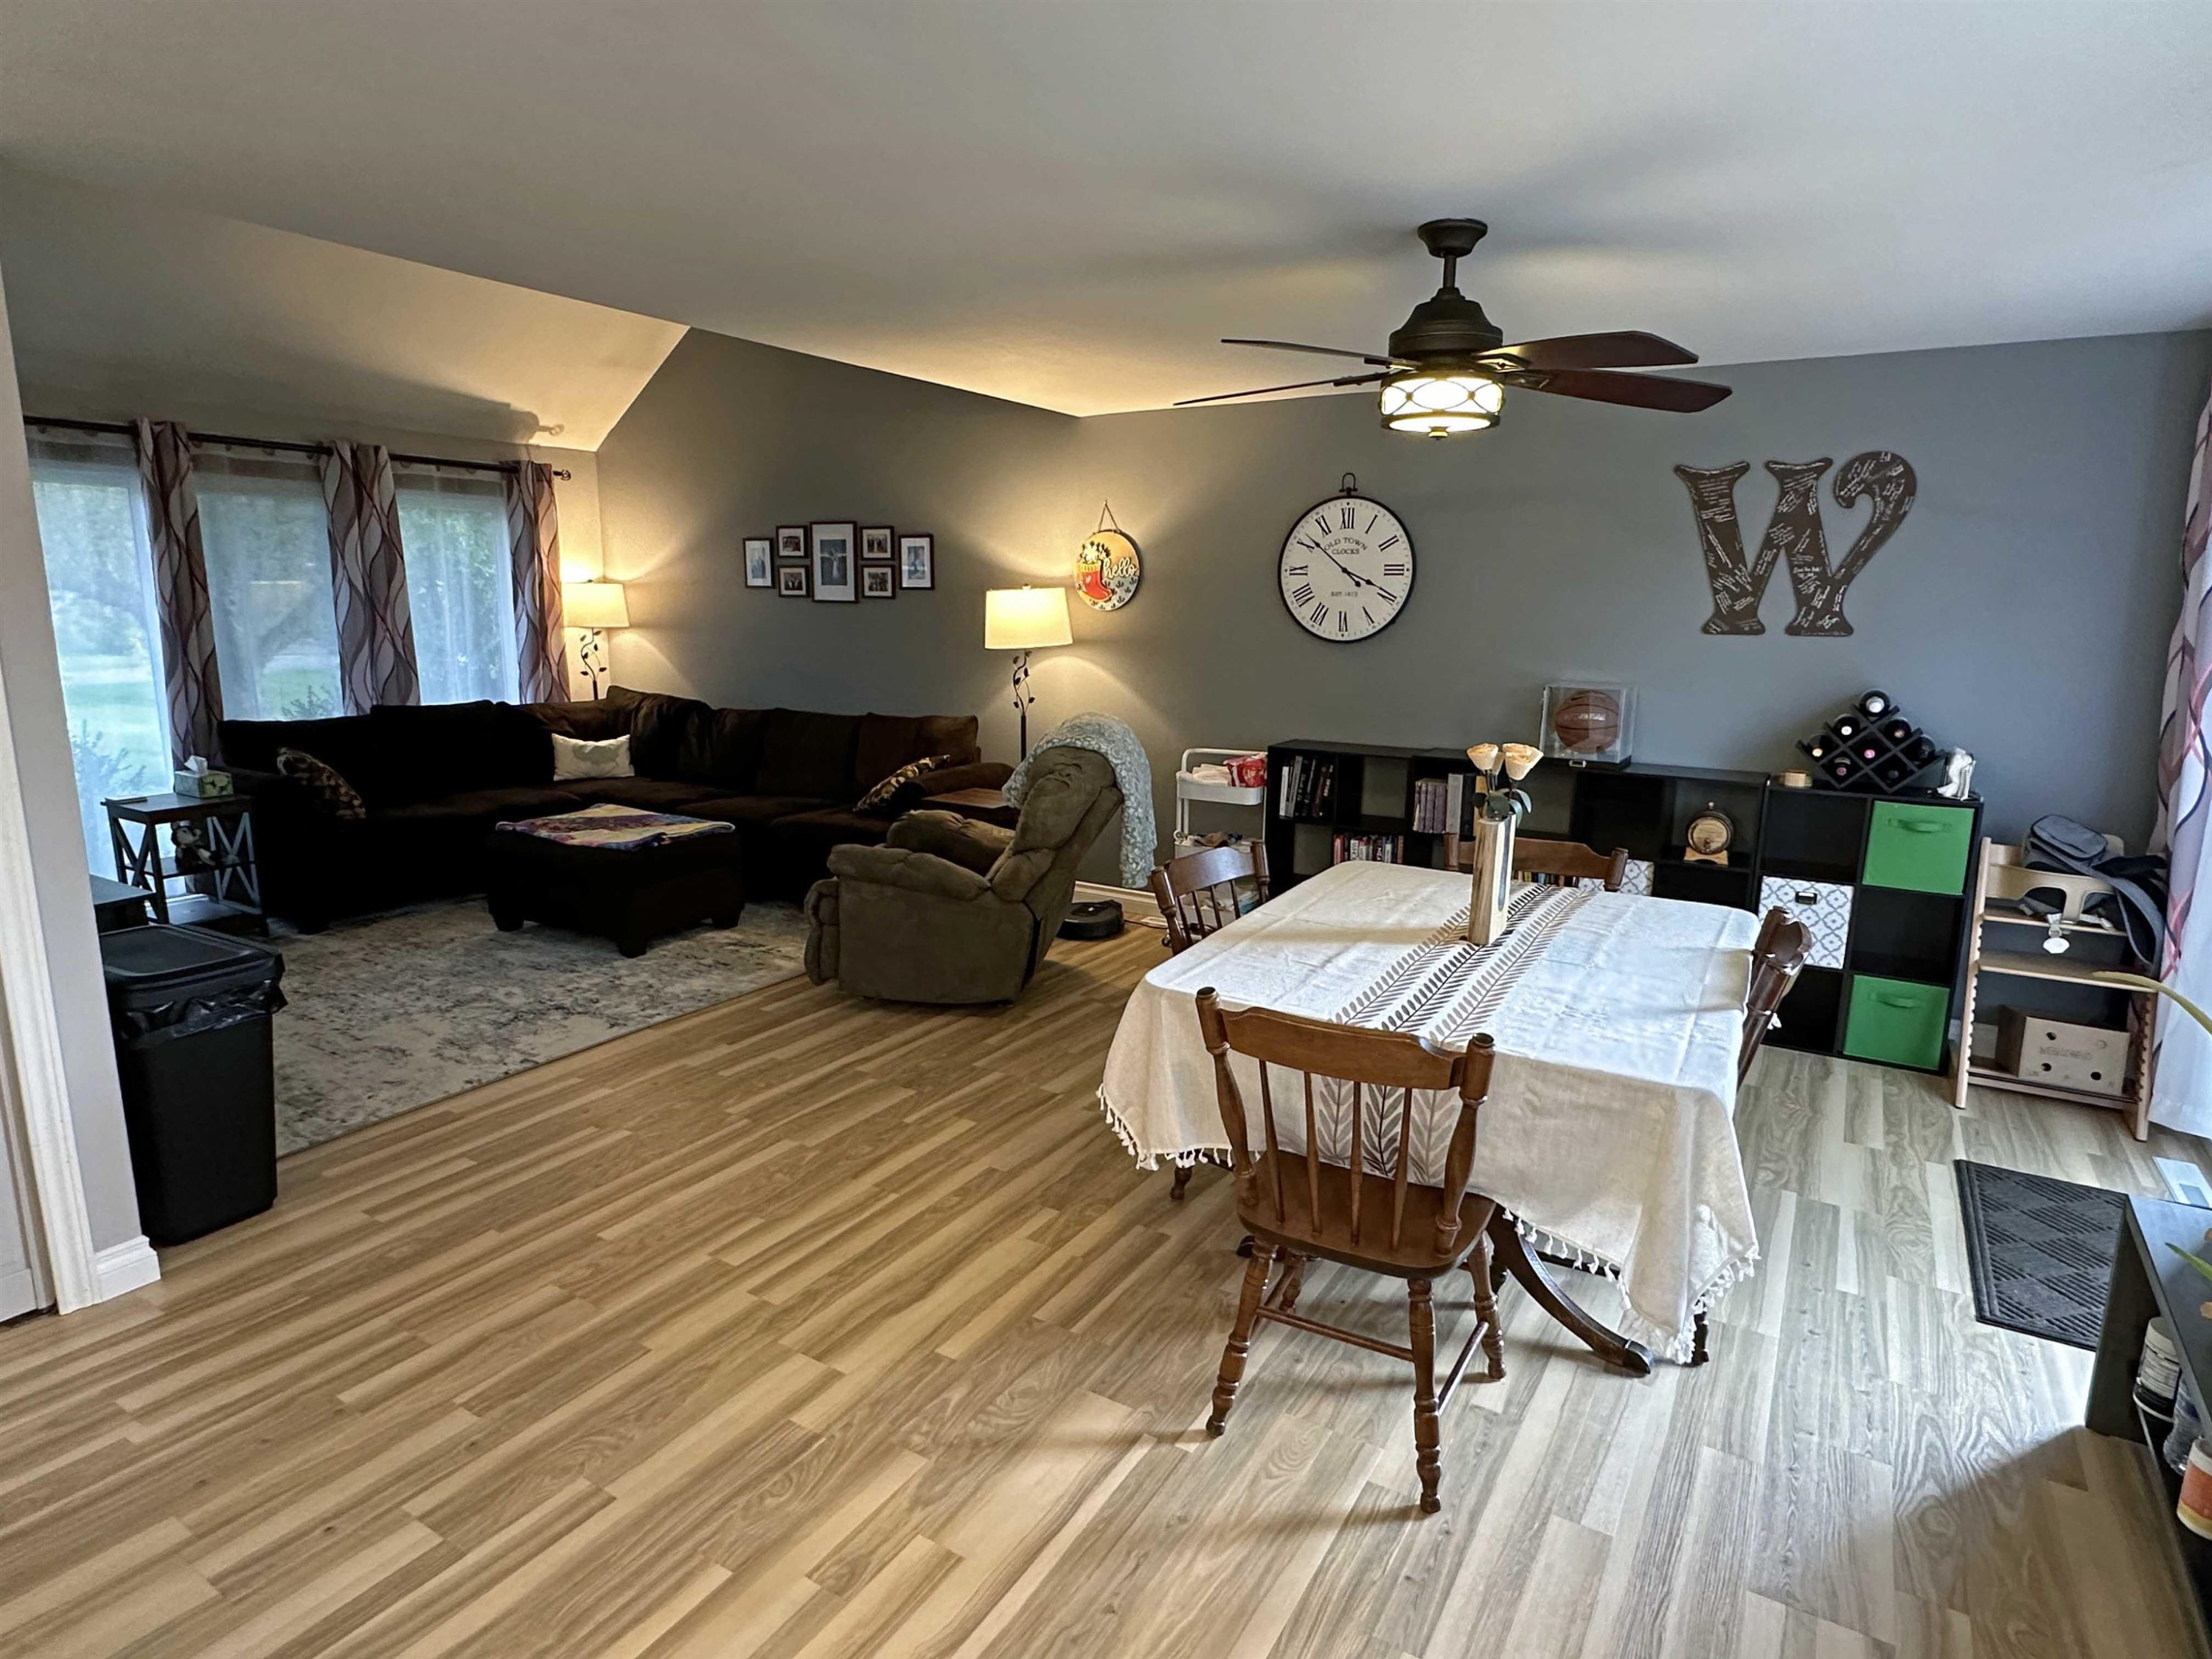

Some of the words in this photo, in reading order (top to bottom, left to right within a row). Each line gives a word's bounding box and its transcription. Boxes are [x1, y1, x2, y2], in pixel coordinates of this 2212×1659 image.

[1340, 507, 1354, 529] XII
[1324, 538, 1341, 551] OLD
[1343, 538, 1368, 551] TOWN
[1103, 557, 1137, 578] hello
